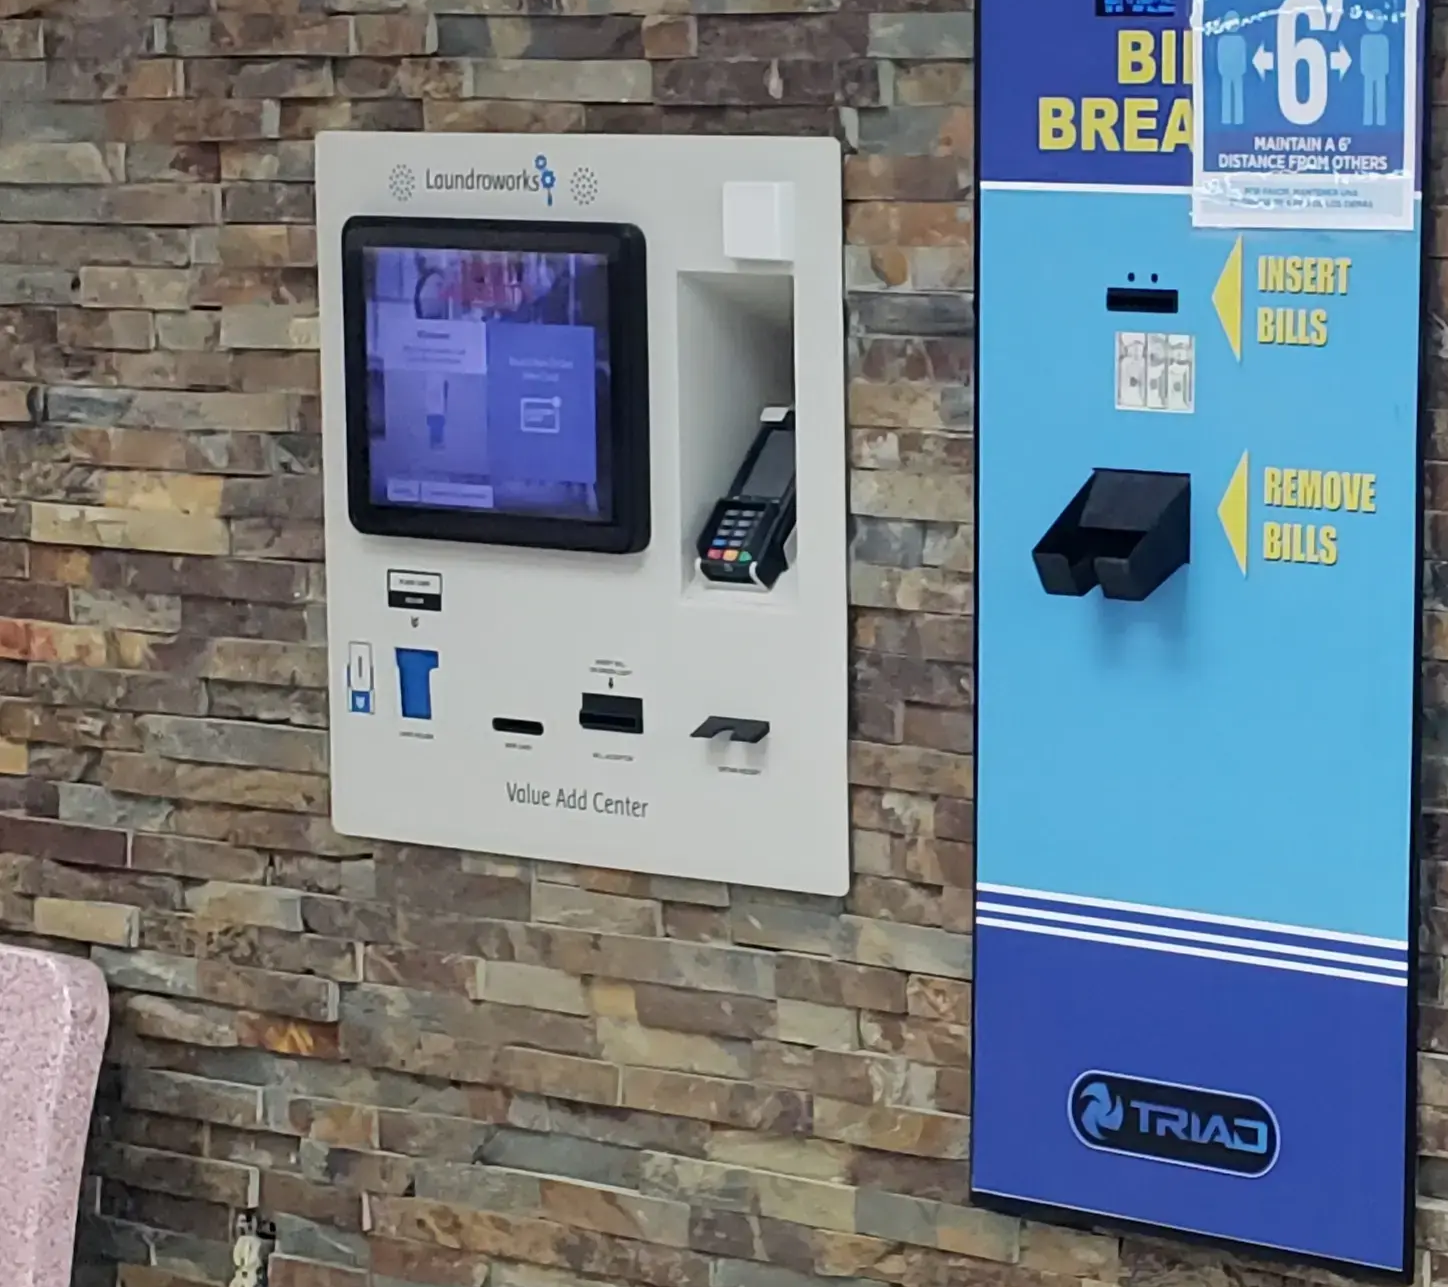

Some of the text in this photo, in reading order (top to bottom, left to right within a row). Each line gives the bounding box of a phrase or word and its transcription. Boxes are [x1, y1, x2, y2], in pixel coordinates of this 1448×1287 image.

[1117, 29, 1193, 84] BI
[1218, 153, 1389, 171] DISTANCE FROM OTHERS
[1254, 136, 1322, 152] MAINTAIN
[1324, 138, 1335, 152] A
[425, 167, 540, 192] Laundroworks
[1256, 255, 1353, 296] INSERT
[1256, 307, 1329, 347] BILLS
[1263, 467, 1378, 514] REMOVE
[1263, 521, 1338, 566] BILLS
[506, 781, 650, 818] Value Add Center
[1130, 1100, 1269, 1154] TRIAD
